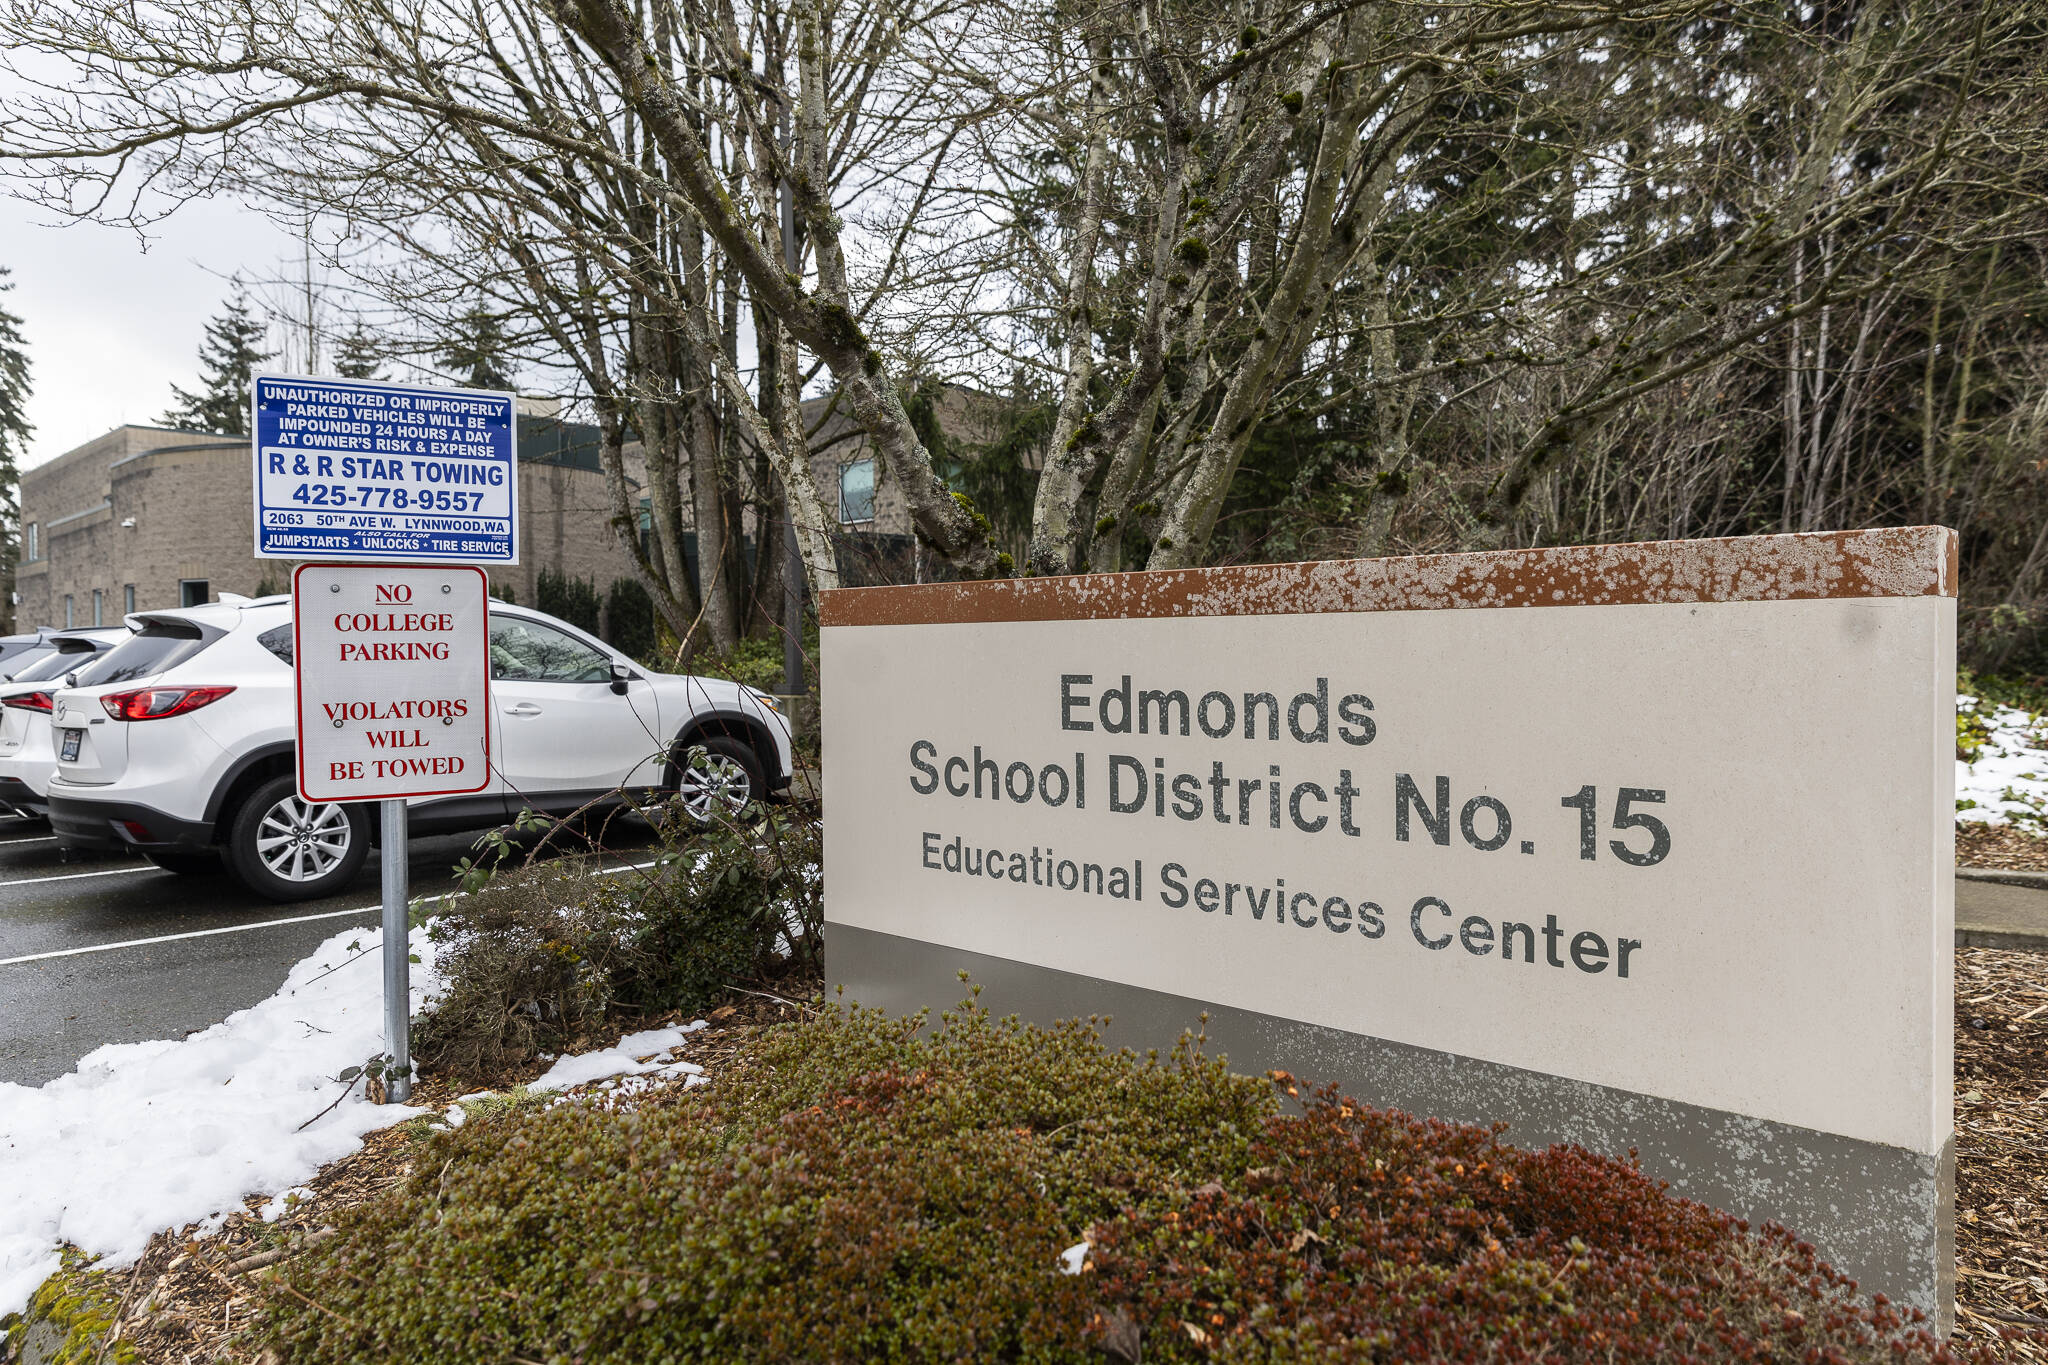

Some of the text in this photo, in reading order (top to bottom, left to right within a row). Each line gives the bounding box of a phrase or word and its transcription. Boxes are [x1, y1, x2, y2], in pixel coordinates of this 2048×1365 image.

[264, 387, 504, 417] UNAUTHORIZED OR IMPROPERLY
[287, 403, 486, 430] PARKED VEHICLES WILL BE
[279, 417, 492, 444] IMPOUNDED 24 HOURS A DAY
[278, 432, 298, 445] AT
[376, 438, 411, 452] RISK
[415, 441, 426, 453] &
[431, 443, 495, 458] EXPENSE
[269, 453, 503, 486] R & R STAR TOWING
[293, 483, 484, 512] 425-778-9557
[269, 512, 304, 525] 2063
[316, 515, 345, 527] 50TH
[348, 516, 377, 528] AVE
[380, 518, 396, 529] W.
[266, 533, 509, 553] JUMPSTARTS UNLOCKS TIRE SERVICE
[375, 584, 413, 603] NO
[334, 613, 454, 632] COLLEGE
[339, 642, 450, 662] PARKING
[322, 699, 468, 721] VIOLATORS
[1060, 673, 1378, 747] Edmonds
[366, 729, 430, 749] WILL
[329, 756, 465, 781] BE TOWED
[909, 739, 1672, 867] School District No. 15
[921, 831, 1642, 979] Educational Services Center
